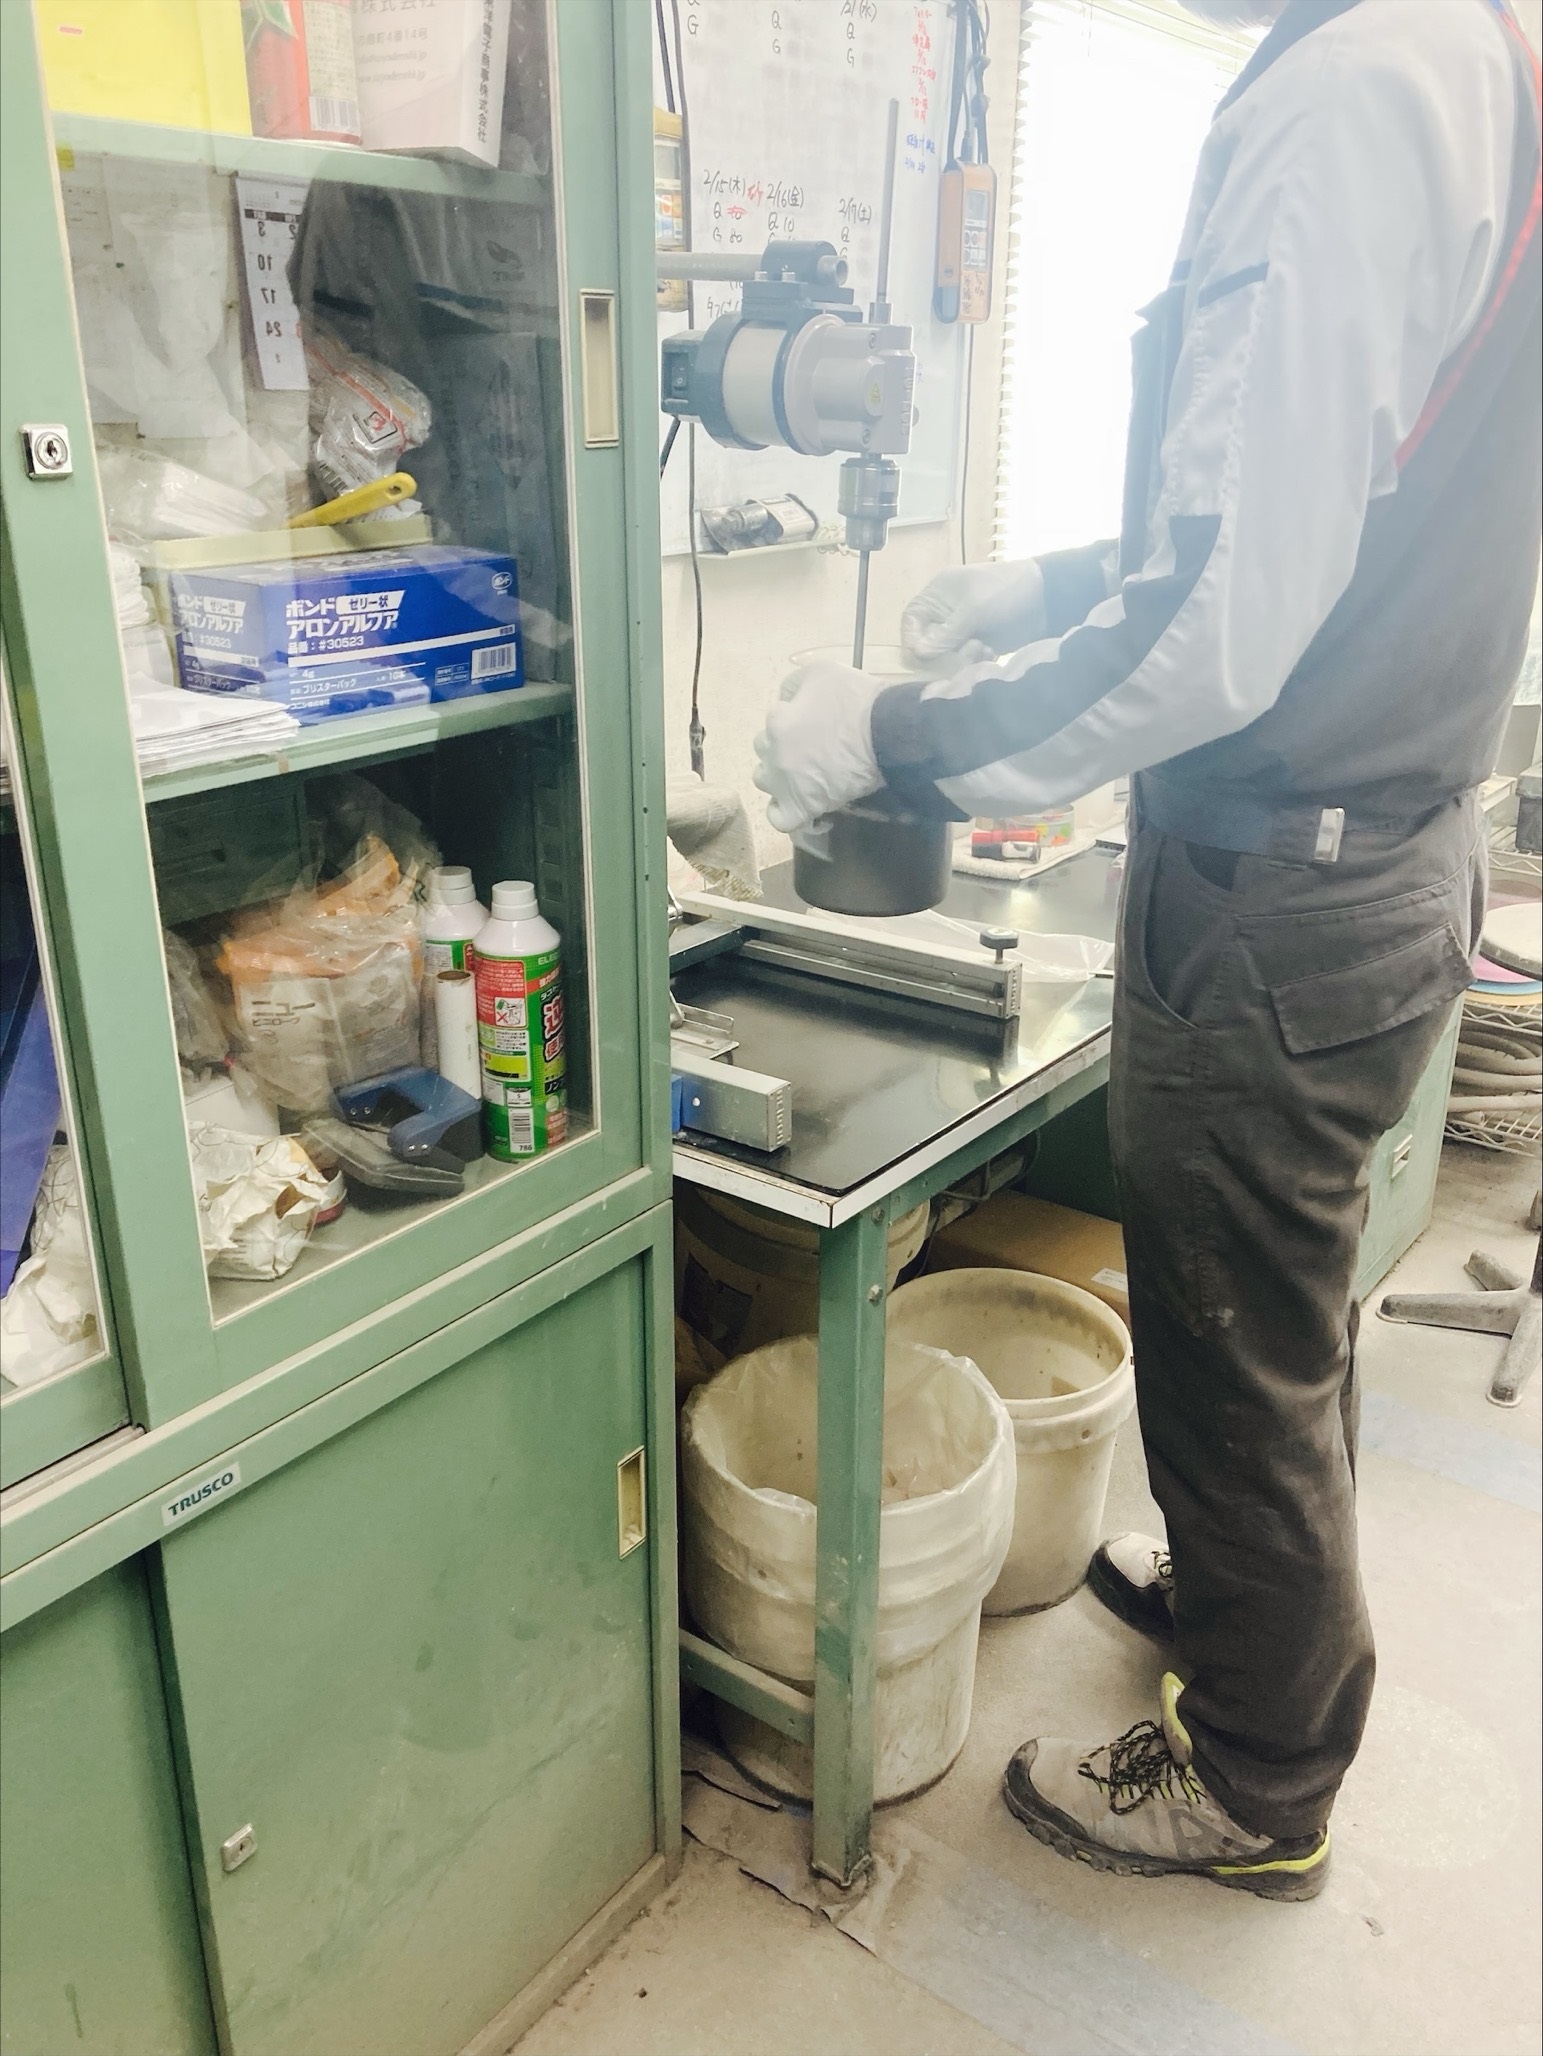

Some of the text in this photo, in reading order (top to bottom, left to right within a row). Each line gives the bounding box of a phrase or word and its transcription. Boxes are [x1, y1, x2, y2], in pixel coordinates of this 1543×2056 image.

[687, 14, 699, 37] G
[771, 10, 782, 30] Q
[846, 22, 855, 40] Q
[772, 38, 781, 55] G
[703, 169, 746, 197] 2/15(木)
[766, 181, 805, 209] 2/16(金)
[838, 197, 872, 225] 2/17(土)
[285, 595, 389, 618] ボンド ゼリー状
[286, 610, 399, 640] アロンアルファ
[168, 1472, 234, 1517] TRUSCO
